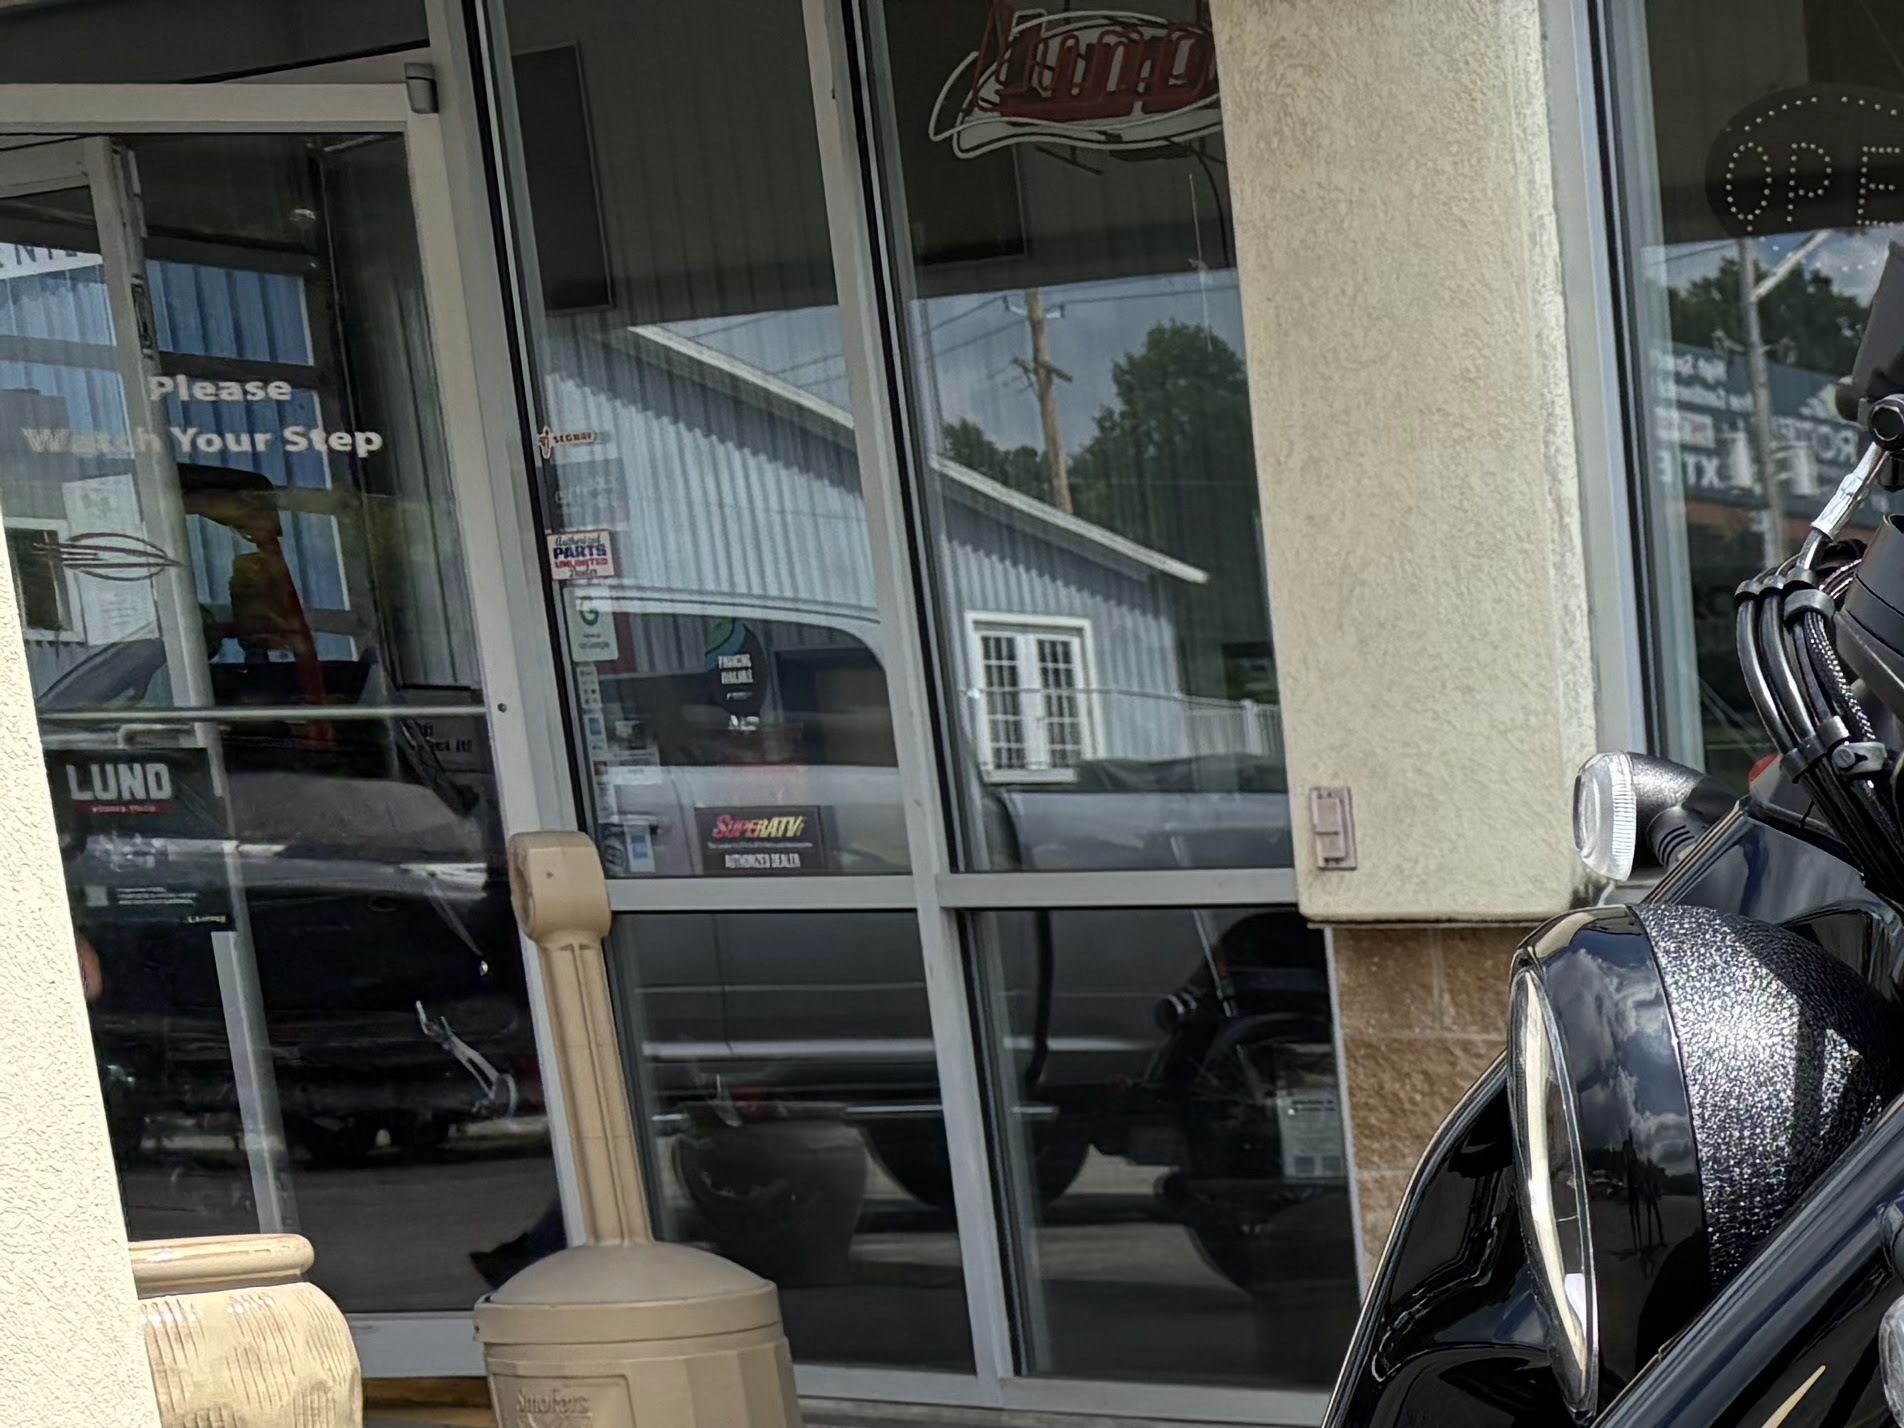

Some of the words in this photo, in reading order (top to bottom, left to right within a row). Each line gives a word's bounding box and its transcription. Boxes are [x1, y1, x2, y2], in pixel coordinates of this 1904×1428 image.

[148, 374, 292, 402] Please
[170, 426, 273, 453] Your
[283, 424, 384, 458] Step
[553, 544, 607, 559] PARTS
[65, 763, 173, 801] LUND
